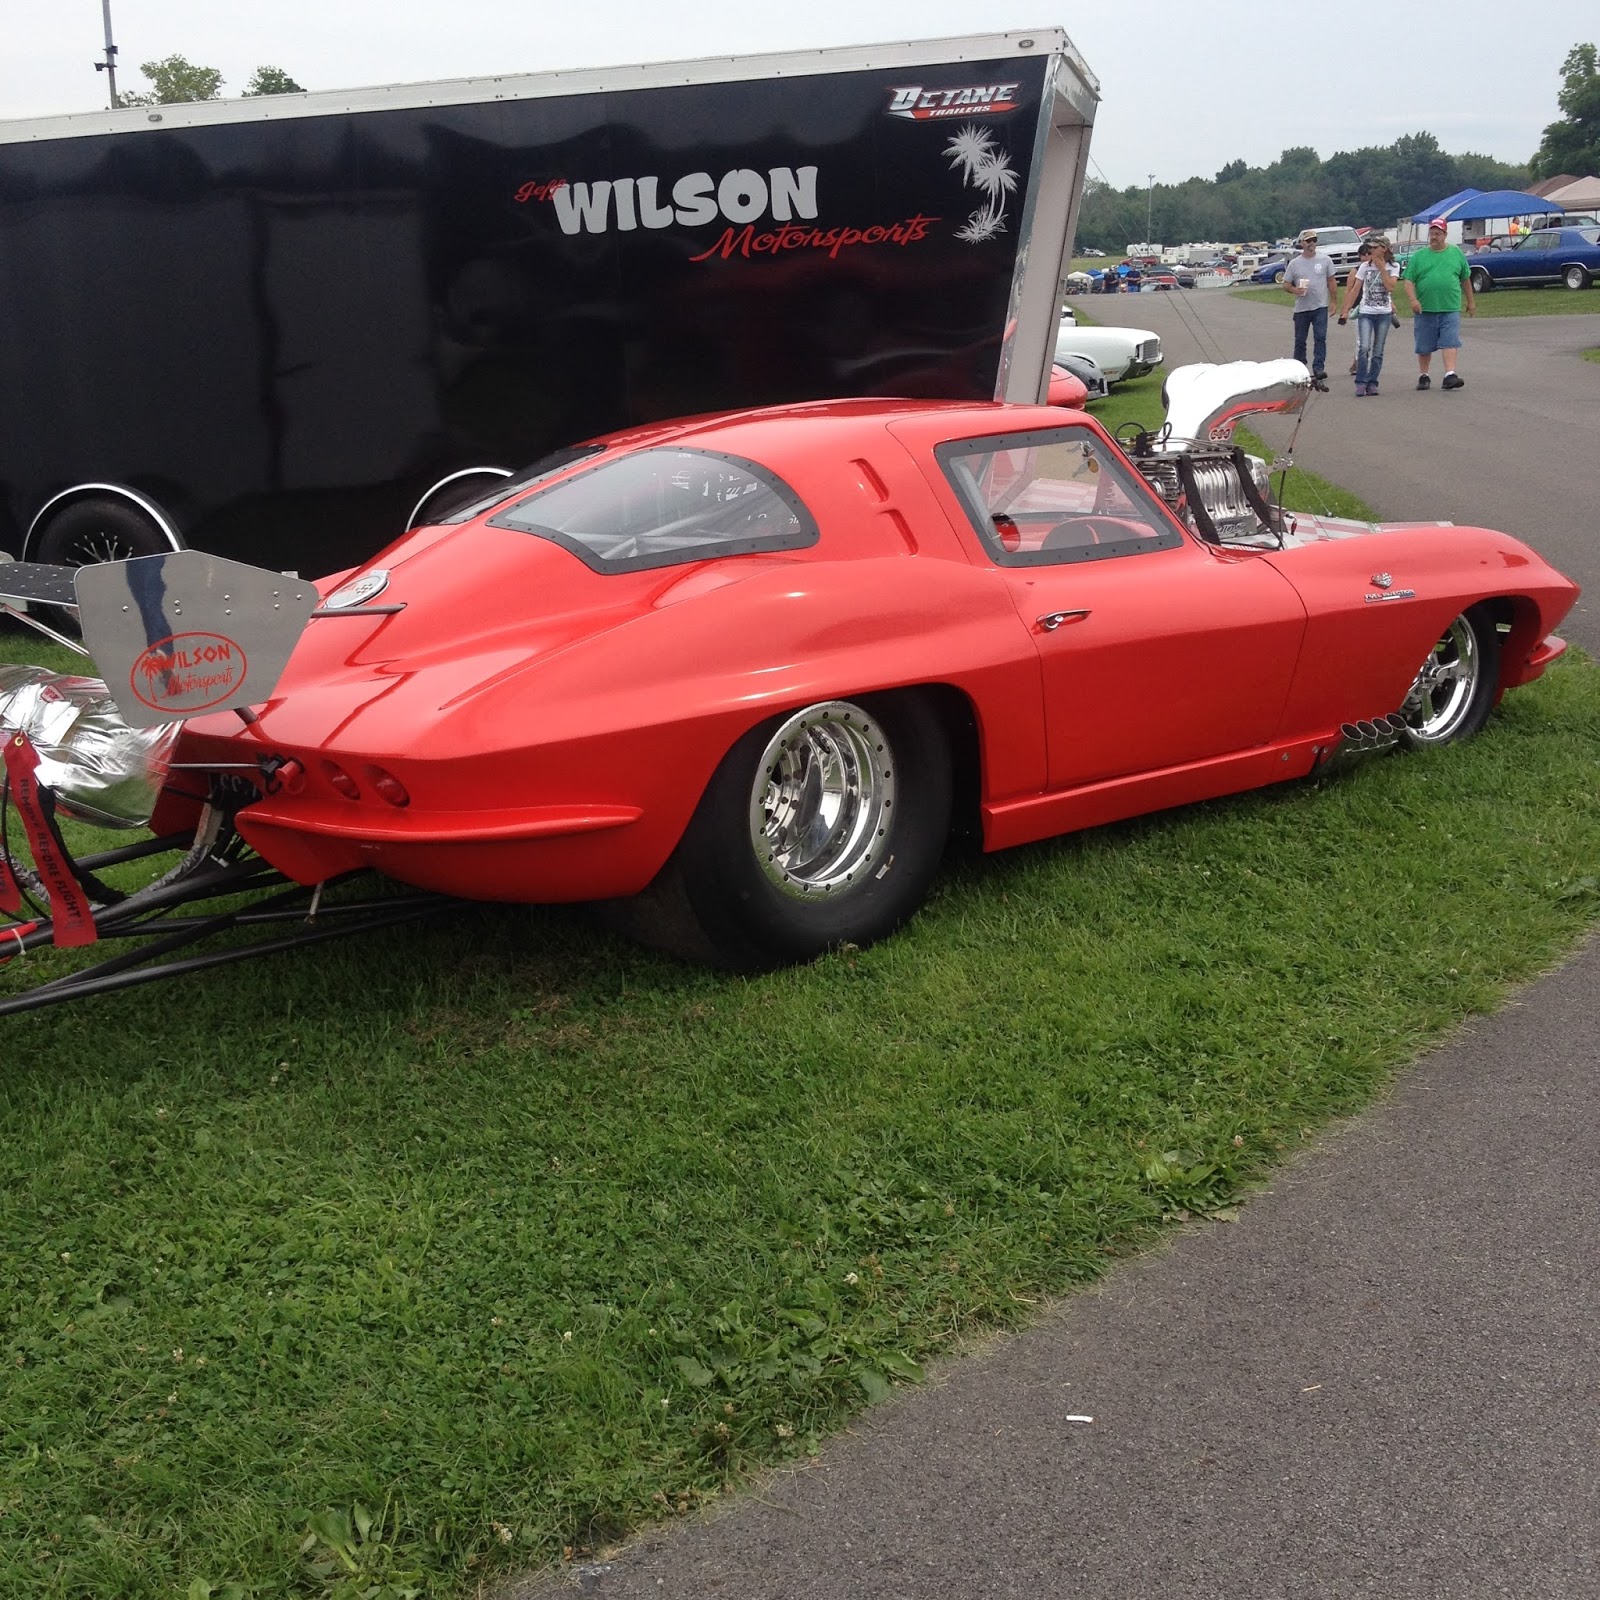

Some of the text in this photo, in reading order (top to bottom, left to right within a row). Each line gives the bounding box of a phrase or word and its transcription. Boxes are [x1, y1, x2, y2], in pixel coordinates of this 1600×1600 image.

[888, 83, 1019, 111] OCTANE
[928, 104, 992, 117] TRAILERS
[513, 165, 819, 236] Jeff WILSON
[688, 212, 942, 263] Motorsports
[37, 832, 59, 877] BEFORE
